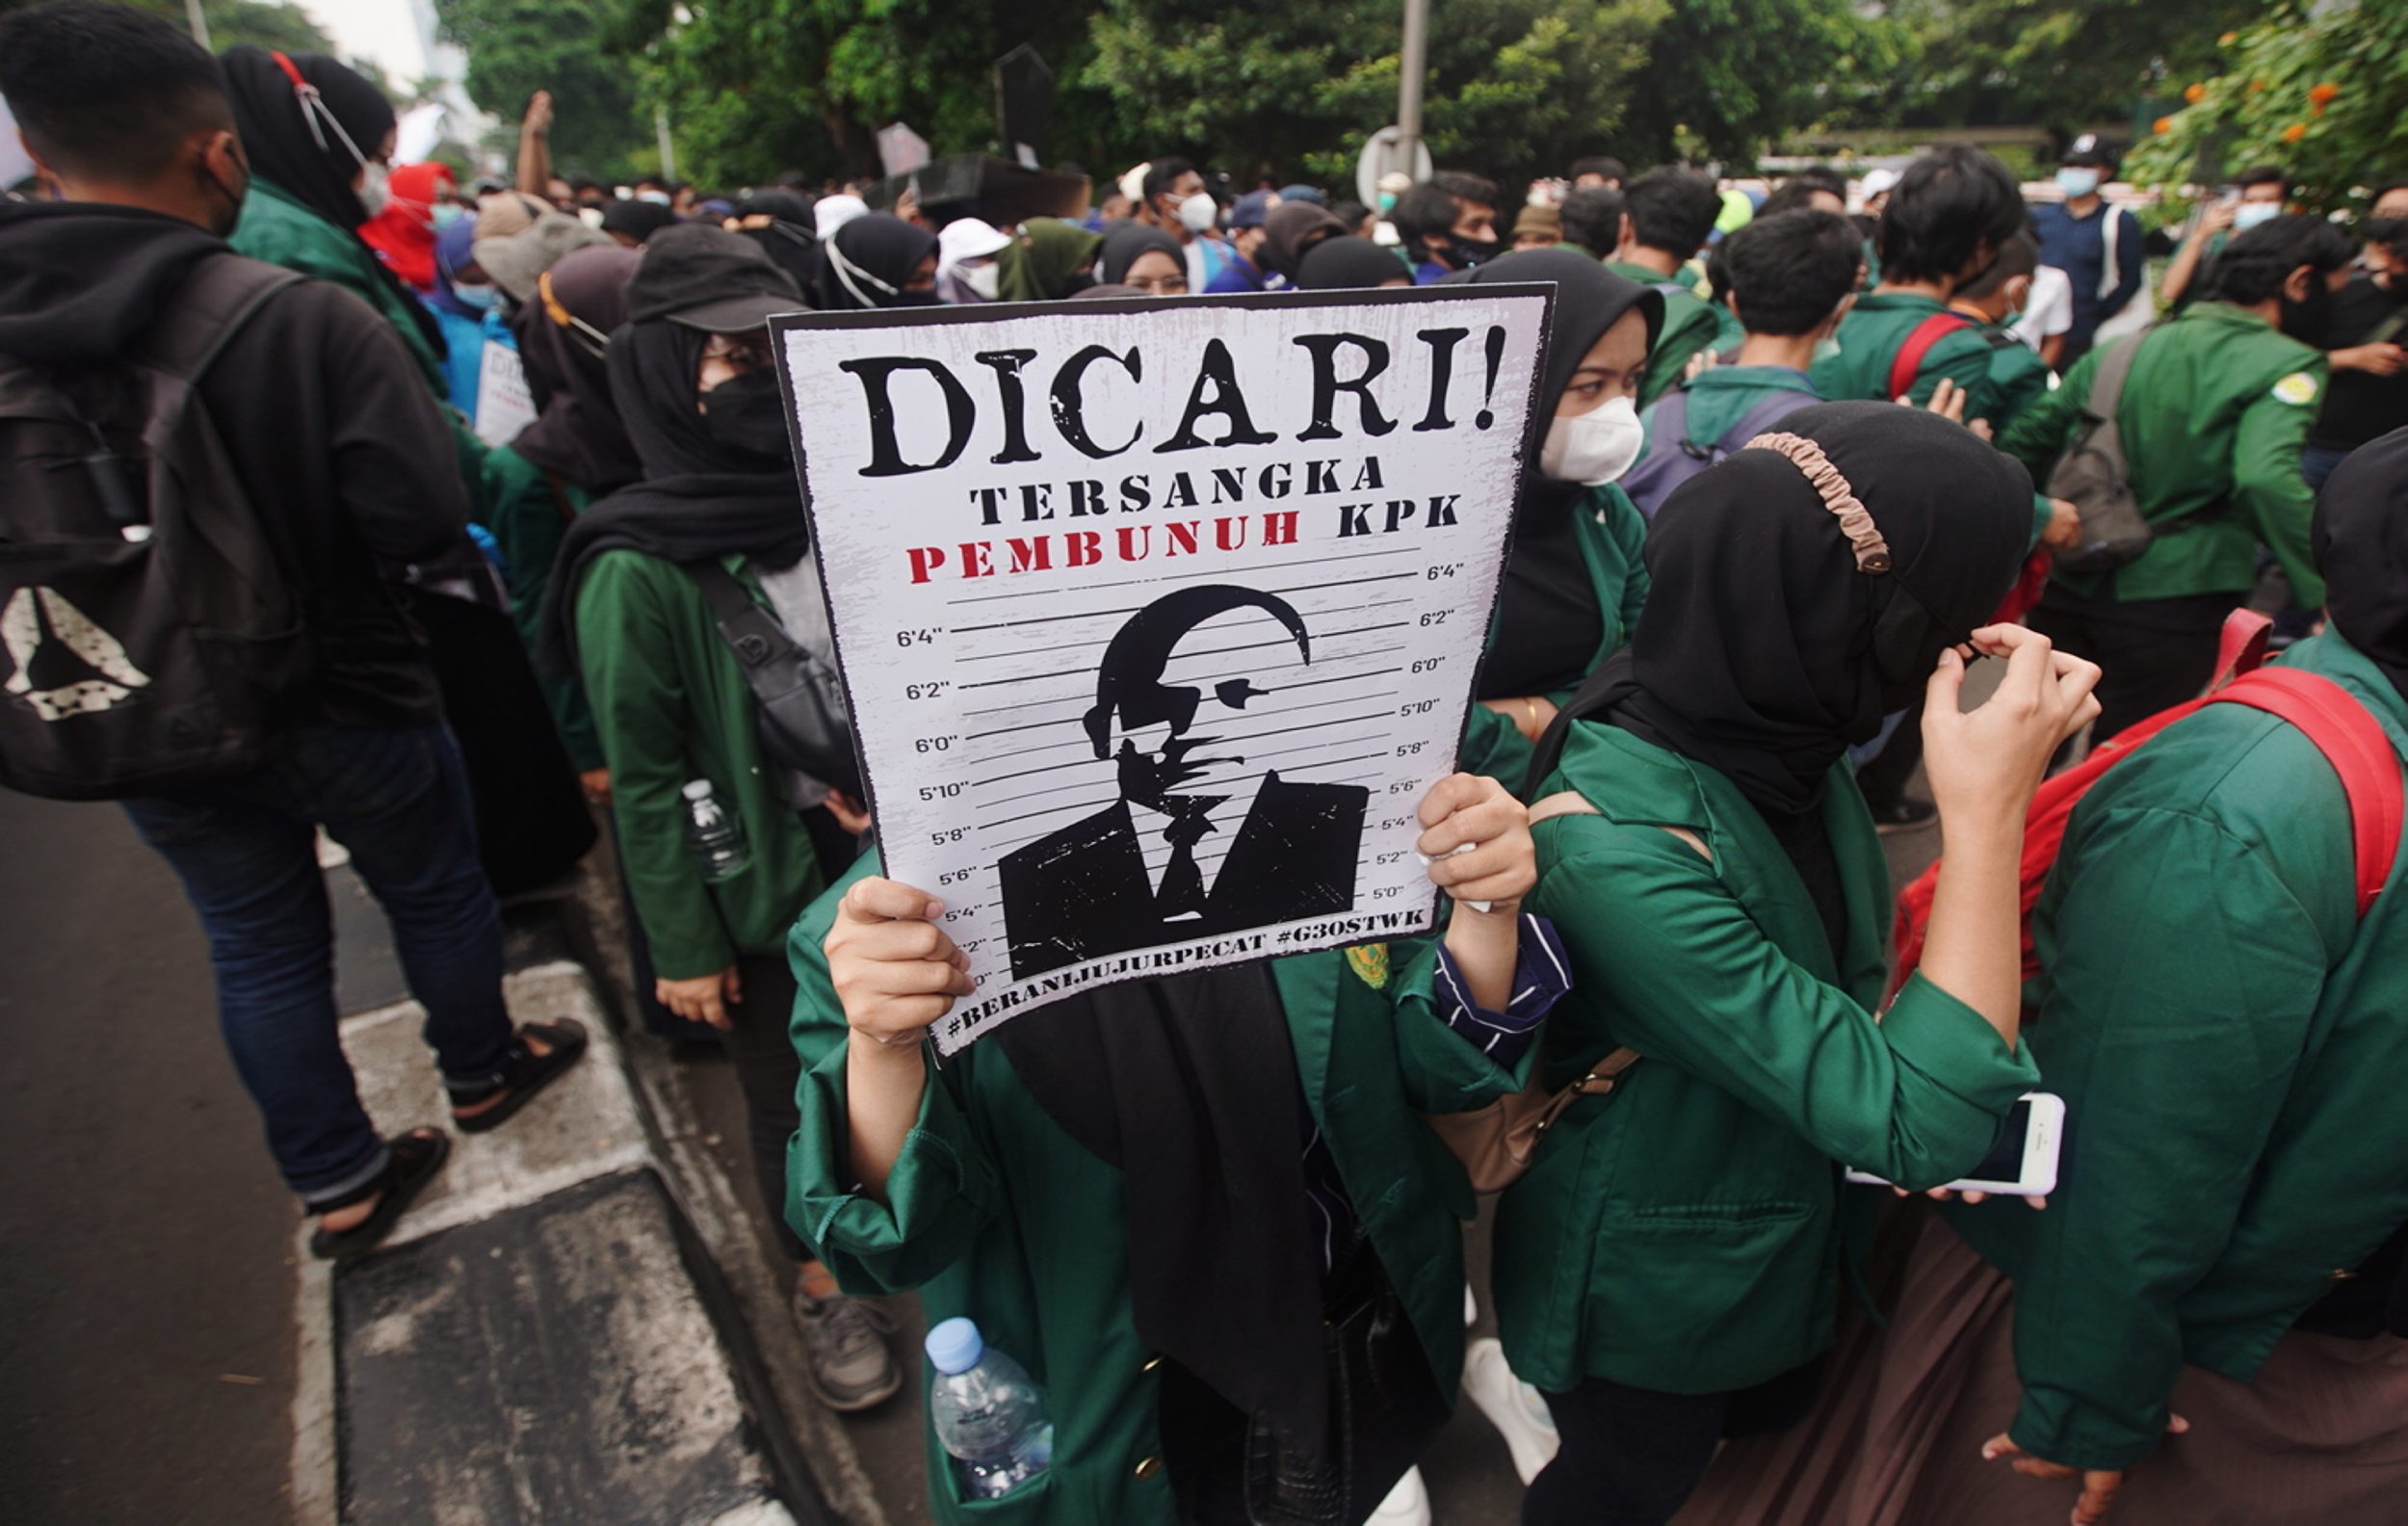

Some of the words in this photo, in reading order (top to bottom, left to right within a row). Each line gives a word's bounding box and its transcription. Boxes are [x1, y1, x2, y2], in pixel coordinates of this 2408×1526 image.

[839, 326, 1505, 477] DICARI!
[970, 456, 1384, 525] TERSANGKA
[906, 511, 1300, 584] PEMBUNUH
[1338, 494, 1461, 539] KPK
[948, 934, 1267, 1038] #BERANIJUJURPECAT
[957, 937, 986, 953] '2"
